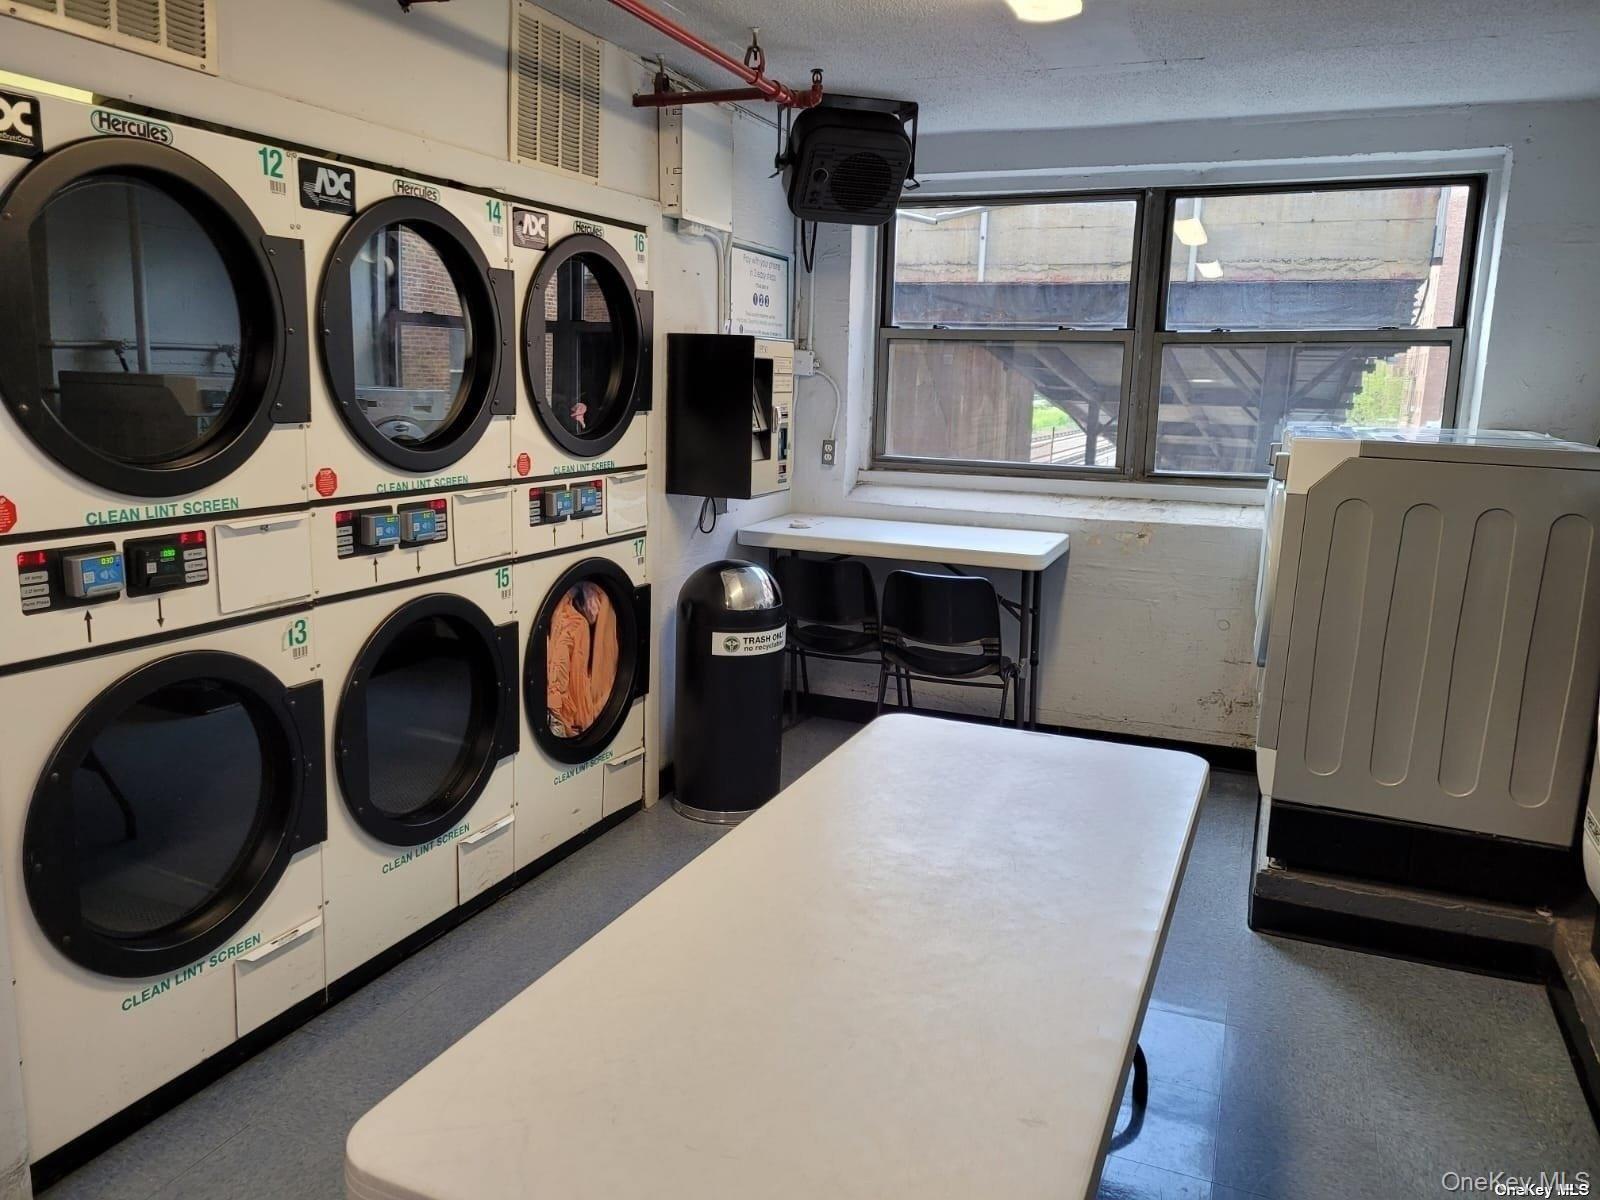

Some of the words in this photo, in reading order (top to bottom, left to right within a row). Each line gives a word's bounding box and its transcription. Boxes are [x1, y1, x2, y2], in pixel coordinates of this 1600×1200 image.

[98, 111, 168, 142] Hercules
[258, 147, 283, 178] 12
[315, 166, 352, 200] ADC
[396, 179, 438, 201] Hercules
[486, 200, 501, 224] 14
[522, 213, 546, 239] ADC
[634, 233, 645, 252] 16
[553, 464, 575, 475] CLEAN
[577, 463, 590, 472] LINT
[591, 460, 615, 471] SCREEN
[376, 481, 409, 493] CLEAN
[411, 479, 432, 489] LINT
[434, 475, 469, 487] SCREEN
[85, 508, 140, 526] CLEAN
[145, 503, 178, 519] LINT
[183, 497, 239, 514] SCREEN
[633, 539, 644, 556] 17
[496, 567, 509, 589] 15
[288, 619, 307, 646] 13
[743, 634, 771, 645] TRASH
[553, 768, 575, 785] CLEAN
[575, 761, 589, 775] LINT
[590, 750, 613, 767] SCREEN
[382, 850, 413, 874] CLEAN
[415, 841, 434, 857] LINT
[436, 823, 470, 846] SCREEN
[121, 978, 171, 1011] CLEAN
[175, 962, 205, 986] LINT
[209, 933, 262, 968] SCREEN
